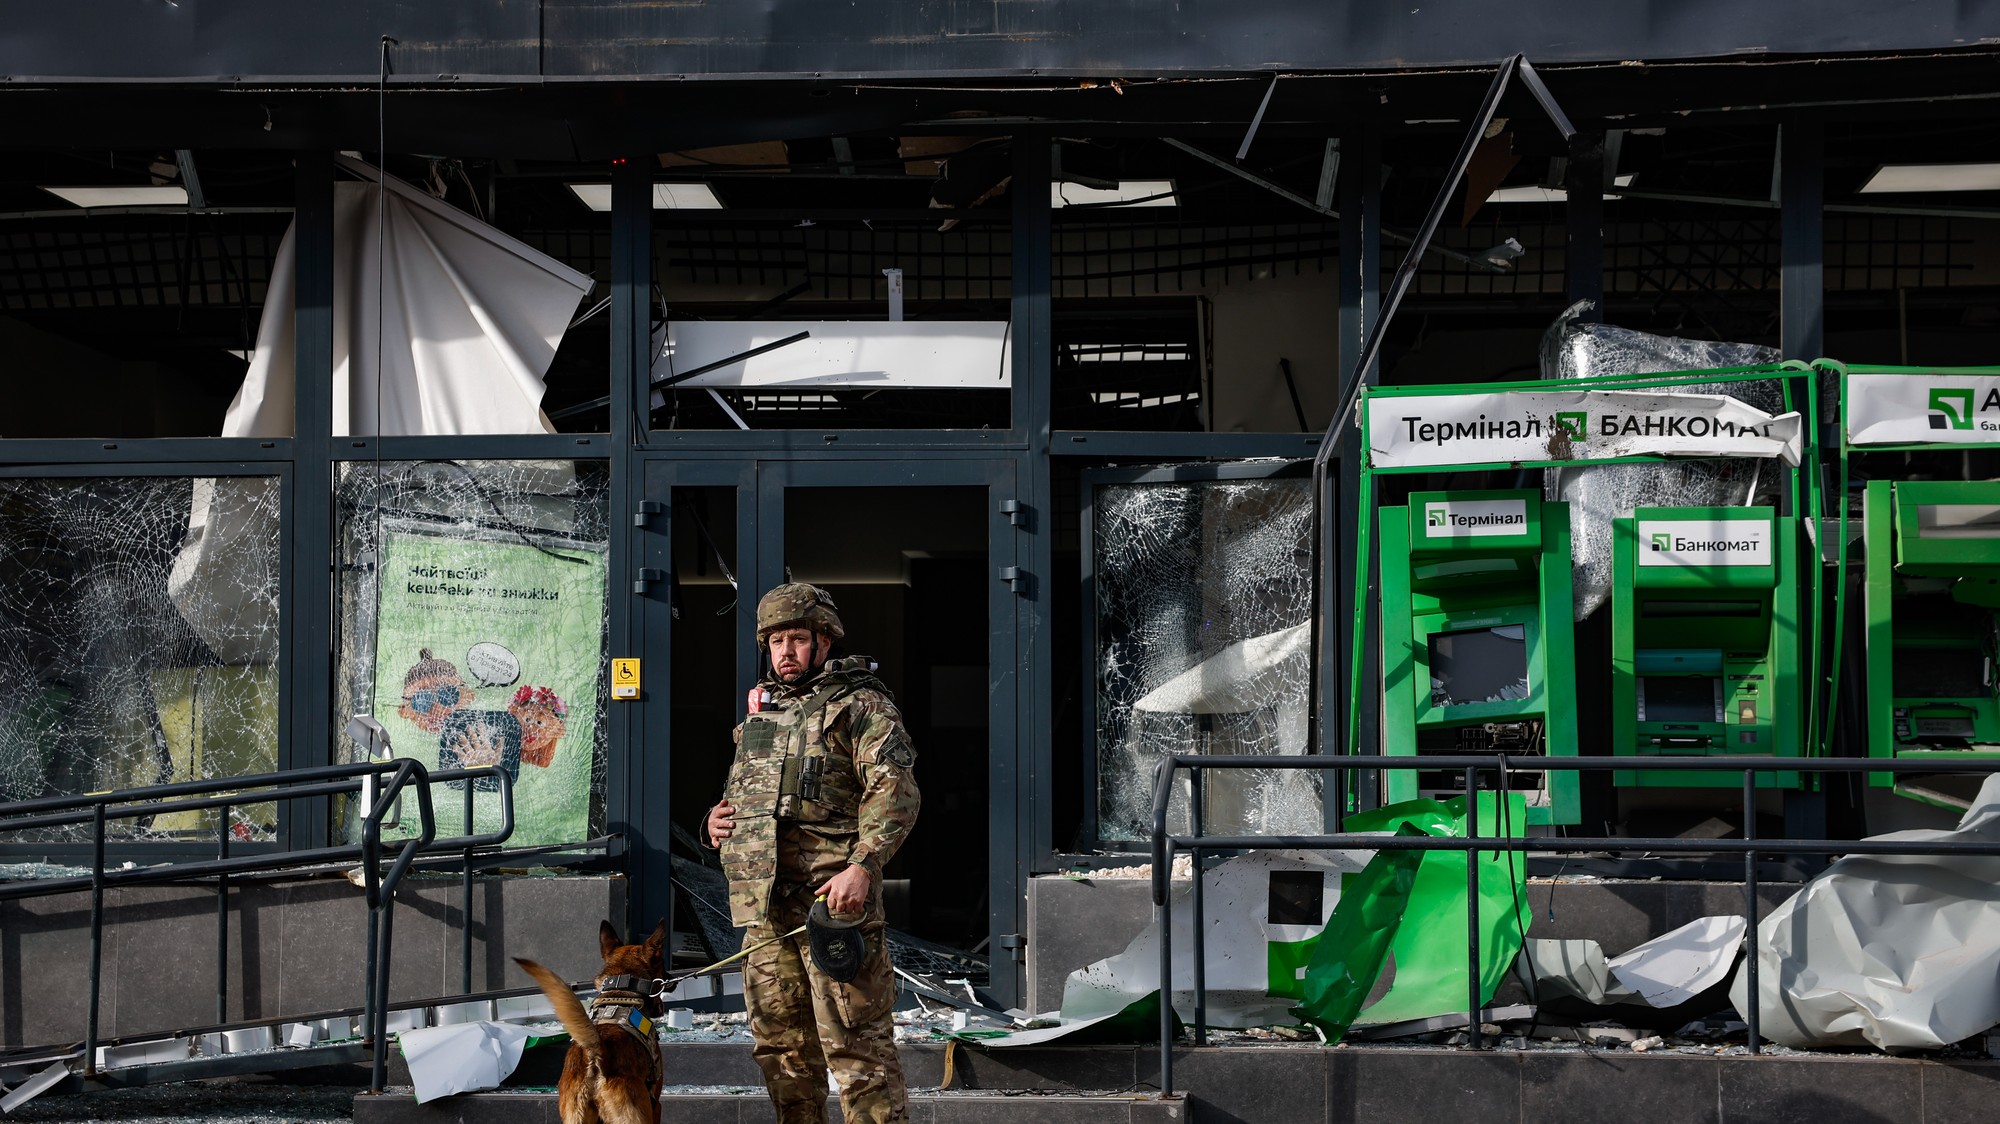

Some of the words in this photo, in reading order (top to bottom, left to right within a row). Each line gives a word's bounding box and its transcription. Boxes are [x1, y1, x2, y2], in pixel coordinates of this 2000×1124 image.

[1402, 414, 1540, 446] Термінал
[1449, 513, 1523, 528] Термінал
[1676, 538, 1759, 551] Банкомат
[501, 587, 559, 600] знижки
